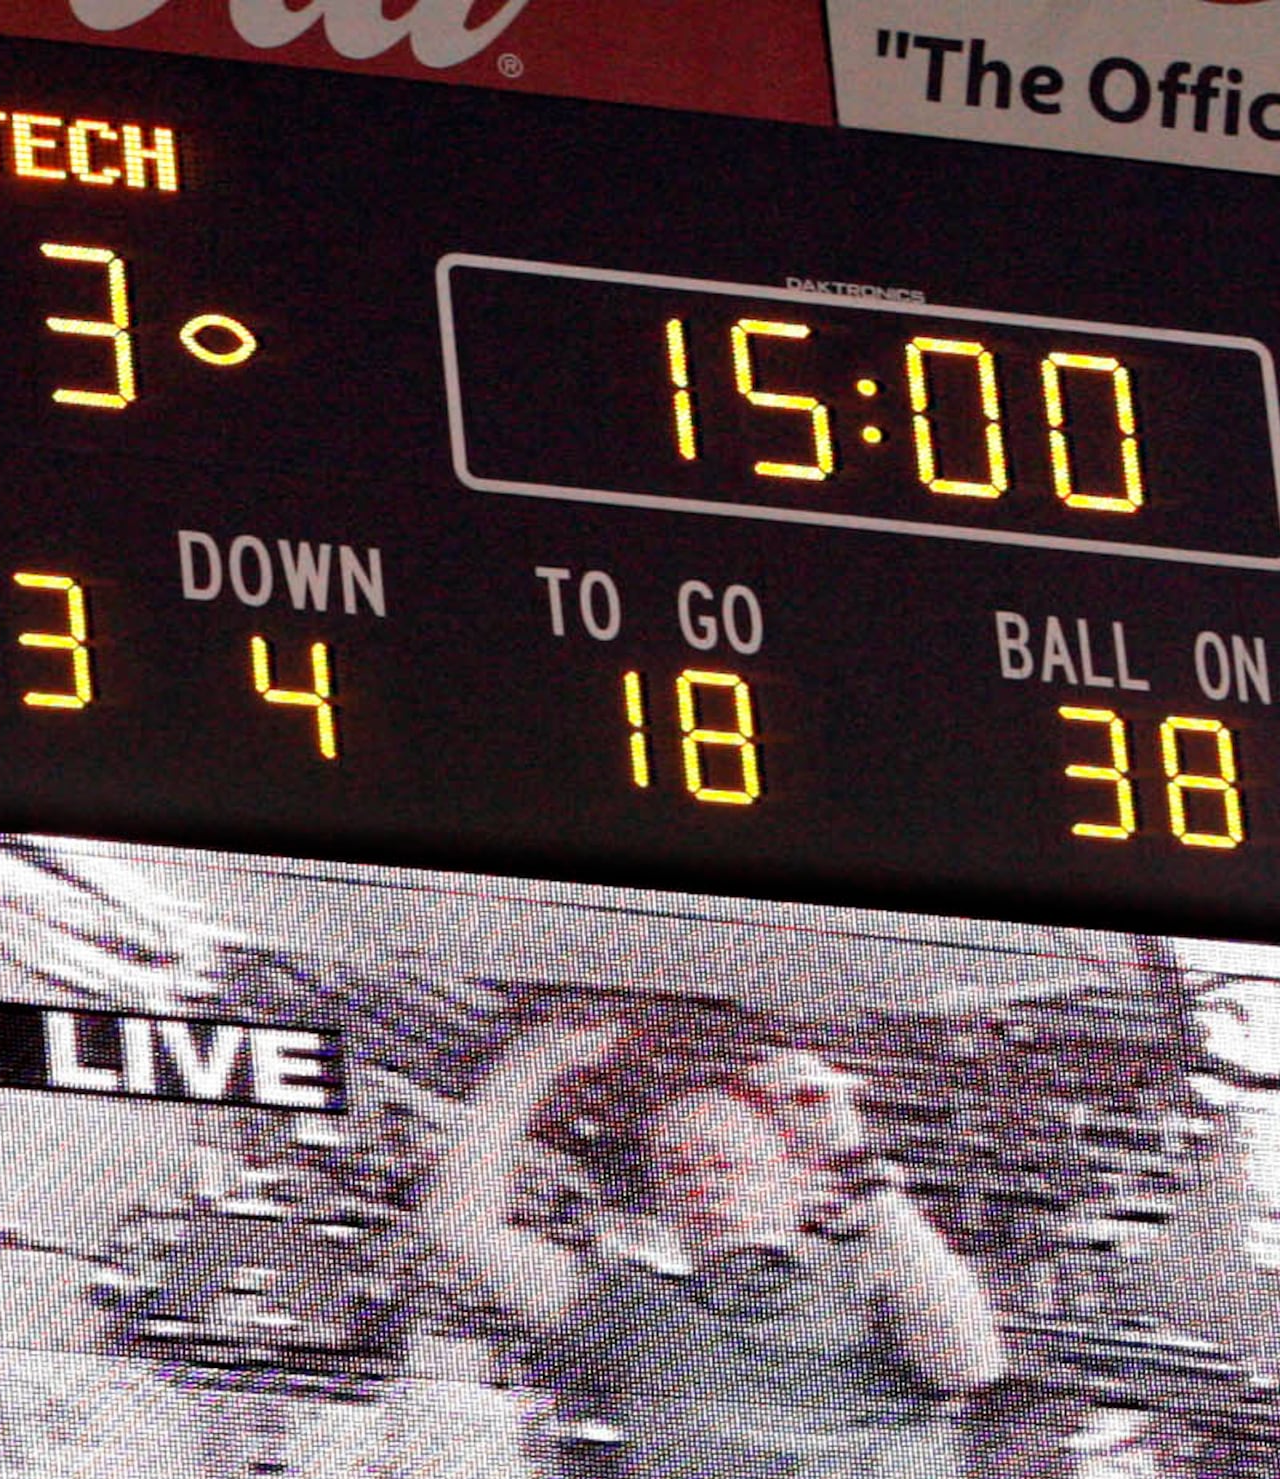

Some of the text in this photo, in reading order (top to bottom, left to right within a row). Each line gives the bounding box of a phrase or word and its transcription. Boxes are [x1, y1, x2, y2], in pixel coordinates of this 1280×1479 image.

[875, 28, 1063, 116] "The
[40, 242, 136, 410] 3
[785, 276, 926, 304] DAKTRONICS
[666, 318, 1143, 514] 15:00
[178, 530, 386, 617] DOWN
[535, 566, 763, 655] TO GO
[14, 572, 93, 710] 3
[994, 611, 1272, 704] BALL ON
[252, 635, 337, 760] 4
[623, 670, 761, 805] 18
[1057, 705, 1243, 848] 38
[43, 1011, 325, 1108] LIVE
